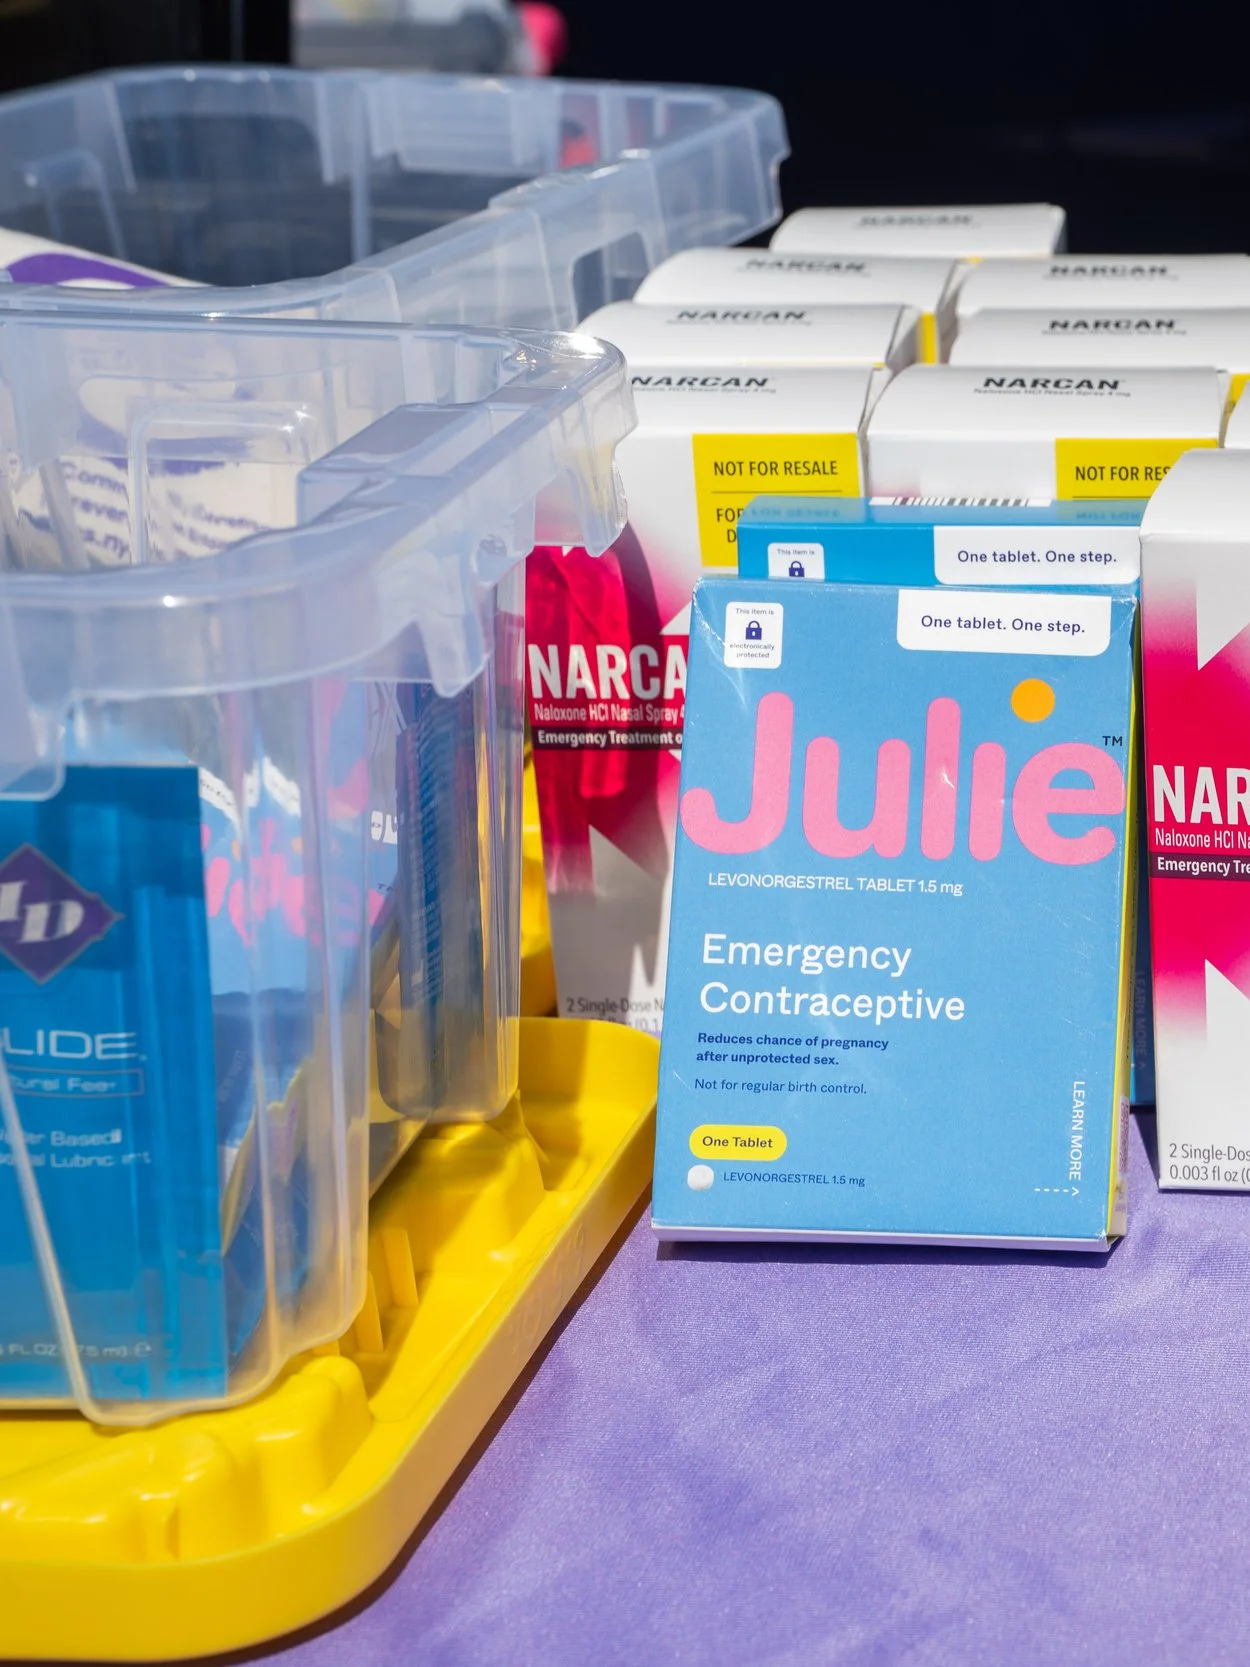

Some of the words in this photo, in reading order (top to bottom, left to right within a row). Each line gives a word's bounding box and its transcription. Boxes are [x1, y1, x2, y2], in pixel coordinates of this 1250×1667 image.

[1050, 319, 1176, 330] NARCAN
[631, 376, 769, 388] NARCAN
[983, 377, 1120, 391] NARCAN
[714, 461, 744, 476] NOT
[749, 461, 779, 476] FOR
[784, 460, 838, 475] RESALE
[957, 550, 988, 563] One
[992, 550, 1041, 563] tablet.
[1045, 551, 1075, 563] One
[1080, 551, 1117, 565] step.
[921, 615, 952, 630] One
[956, 616, 1007, 631] tablet.
[1011, 618, 1043, 632] One
[1046, 619, 1086, 635] step.
[729, 643, 775, 651] electronically
[527, 643, 688, 700] NARCA
[679, 678, 1127, 866] Julie
[1155, 829, 1211, 848] Naloxone
[1157, 857, 1231, 878] Emergency
[708, 872, 854, 892] LEVONORGESTREL
[856, 877, 916, 893] TABLET
[917, 879, 937, 894] 1.5
[939, 882, 963, 897] mg
[702, 932, 912, 978] Emergency
[699, 980, 966, 1026] Contraceptive
[0, 1027, 138, 1060] LIDE
[697, 1032, 753, 1046] Reduces
[756, 1034, 802, 1047] chance
[804, 1035, 819, 1048] of
[821, 1038, 889, 1051] pregnancy
[696, 1051, 728, 1063] after
[731, 1052, 811, 1065] unprotected
[814, 1055, 839, 1066] sex.
[694, 1079, 718, 1090] Not
[720, 1079, 738, 1091] for
[741, 1079, 785, 1094] regular
[788, 1080, 818, 1093] birth
[820, 1081, 867, 1094] control.
[1071, 1081, 1086, 1131] LEARN
[702, 1136, 730, 1148] One
[733, 1136, 773, 1149] Tablet
[1169, 1143, 1178, 1159] 2
[1068, 1134, 1084, 1181] MORE
[723, 1172, 830, 1184] LEVONORGESTREL
[832, 1175, 847, 1185] 1.5
[849, 1177, 865, 1187] mg
[1170, 1164, 1208, 1180] 0.003
[1211, 1165, 1220, 1181] fl
[1222, 1170, 1239, 1182] oz
